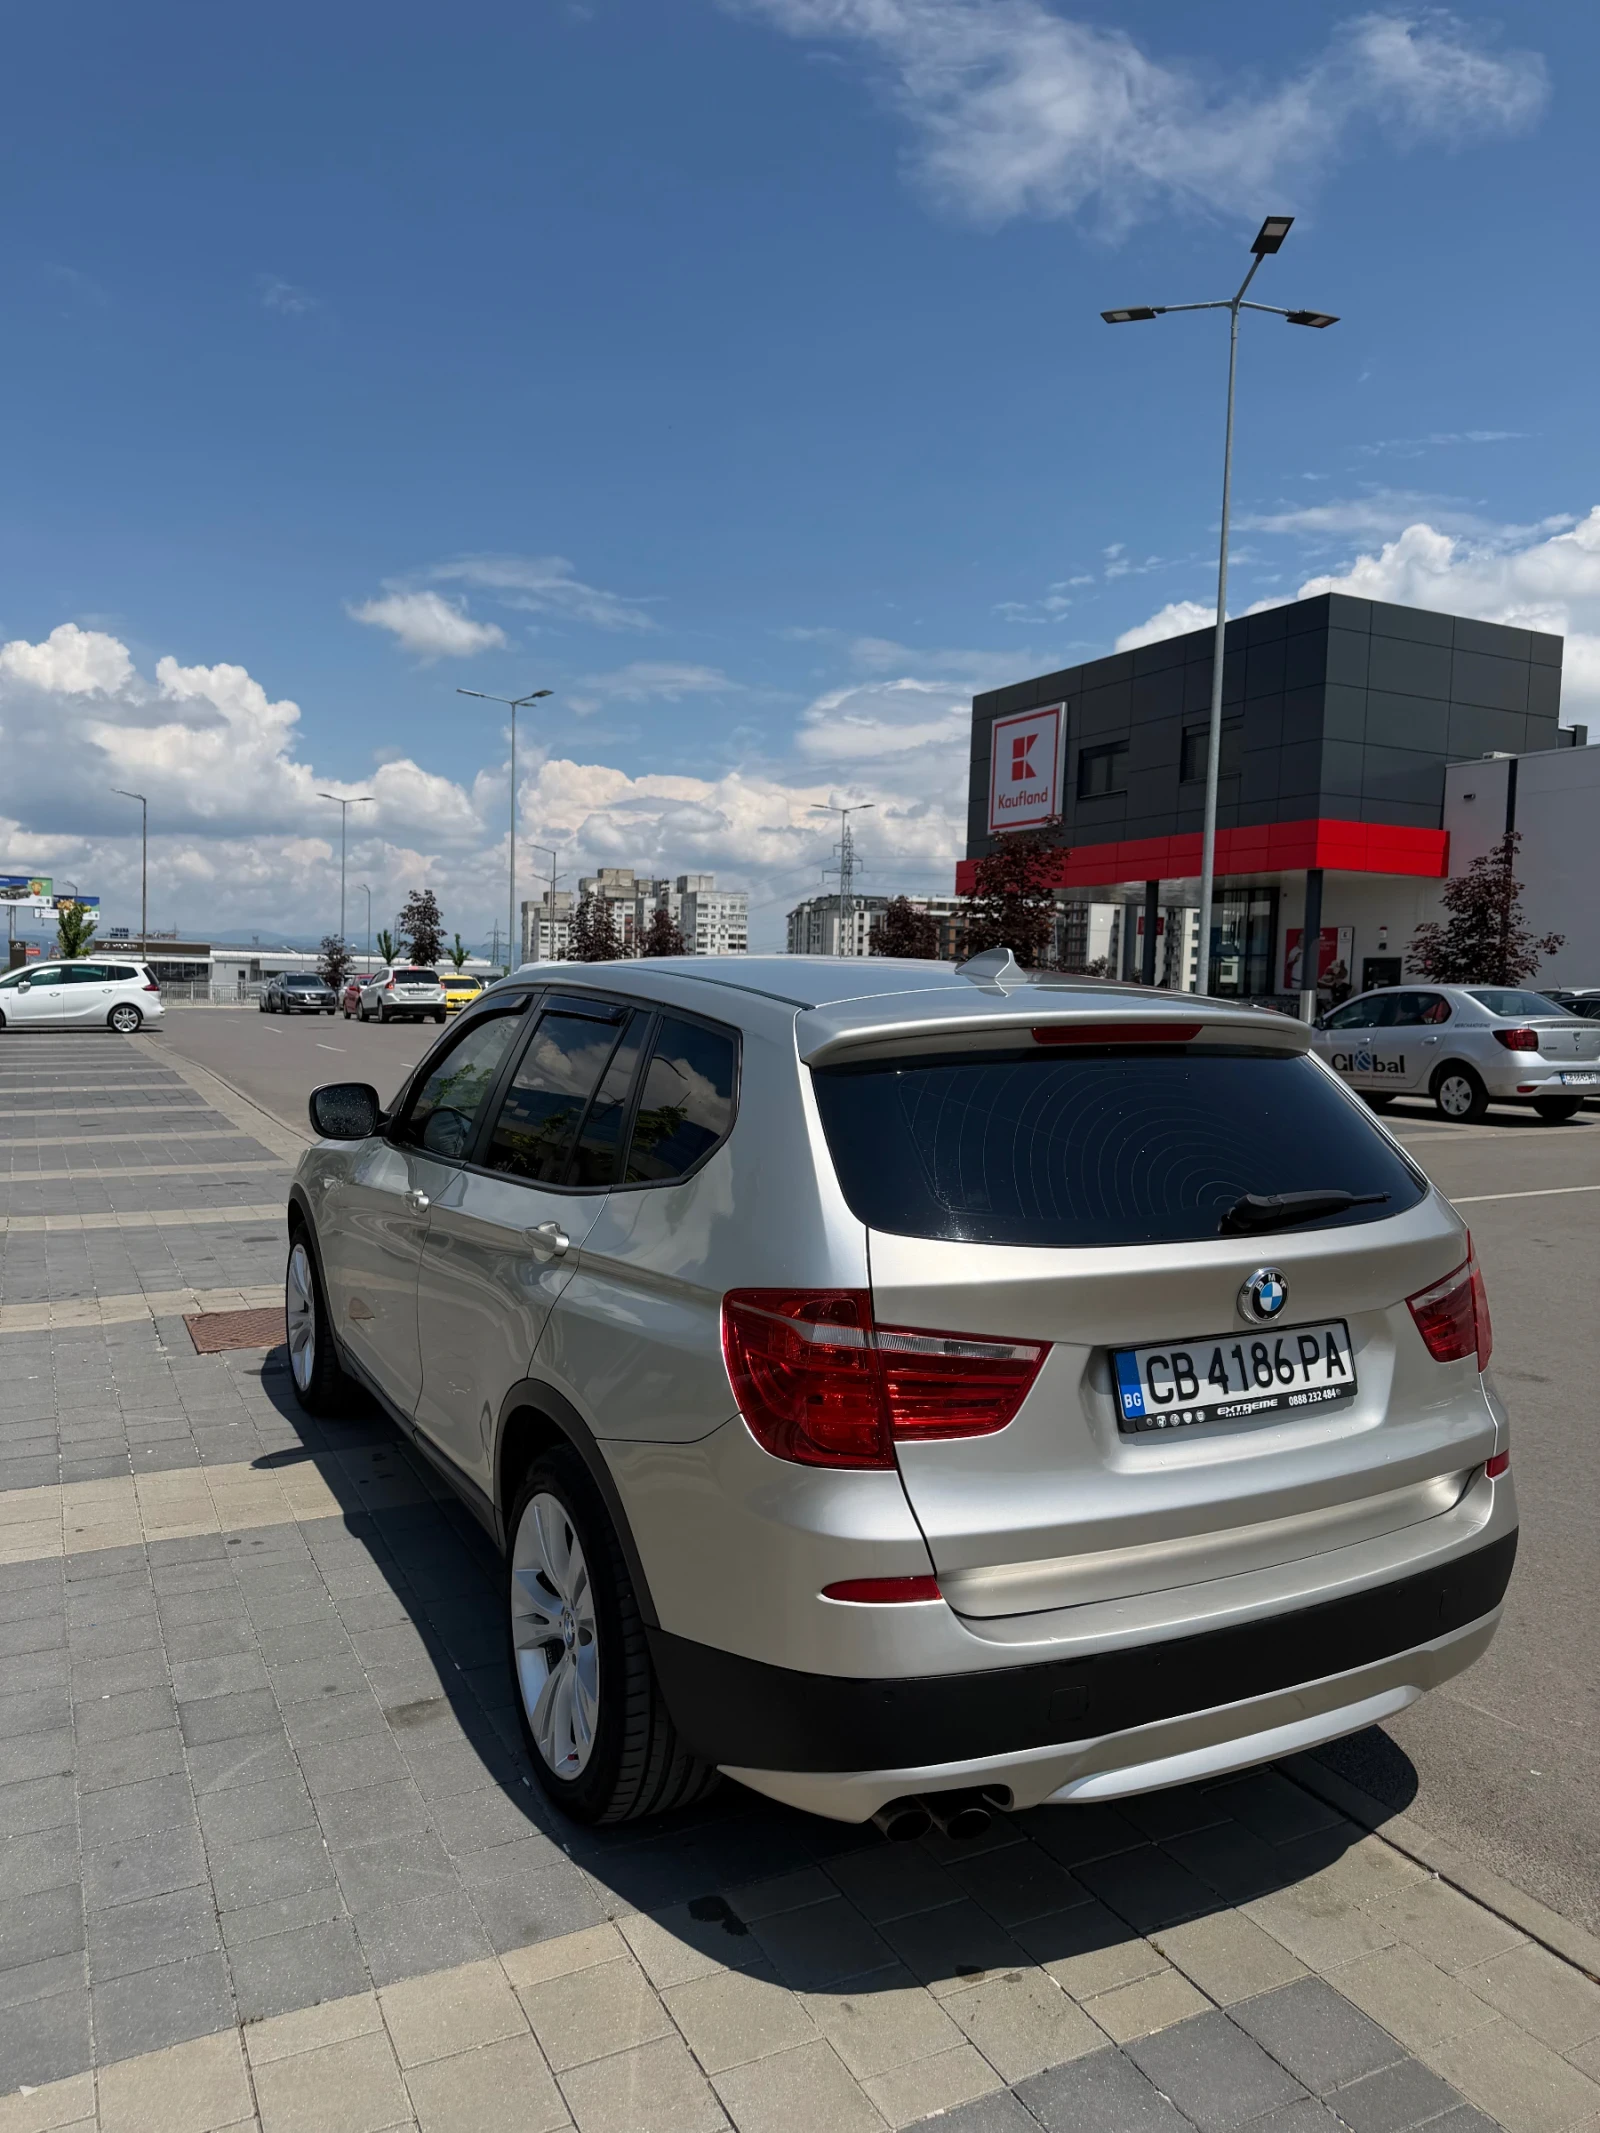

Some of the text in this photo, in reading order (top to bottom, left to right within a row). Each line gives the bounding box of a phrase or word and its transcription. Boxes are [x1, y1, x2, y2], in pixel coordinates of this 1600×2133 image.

[998, 786, 1049, 810] Kaufland
[1255, 1273, 1287, 1291] BMW
[1146, 1331, 1347, 1404] CB 4186 PA
[1123, 1392, 1142, 1408] BG
[1217, 1398, 1279, 1416] EXTREME
[1288, 1393, 1308, 1406] 0888
[1308, 1391, 1323, 1403] 232
[1322, 1388, 1337, 1399] 484
